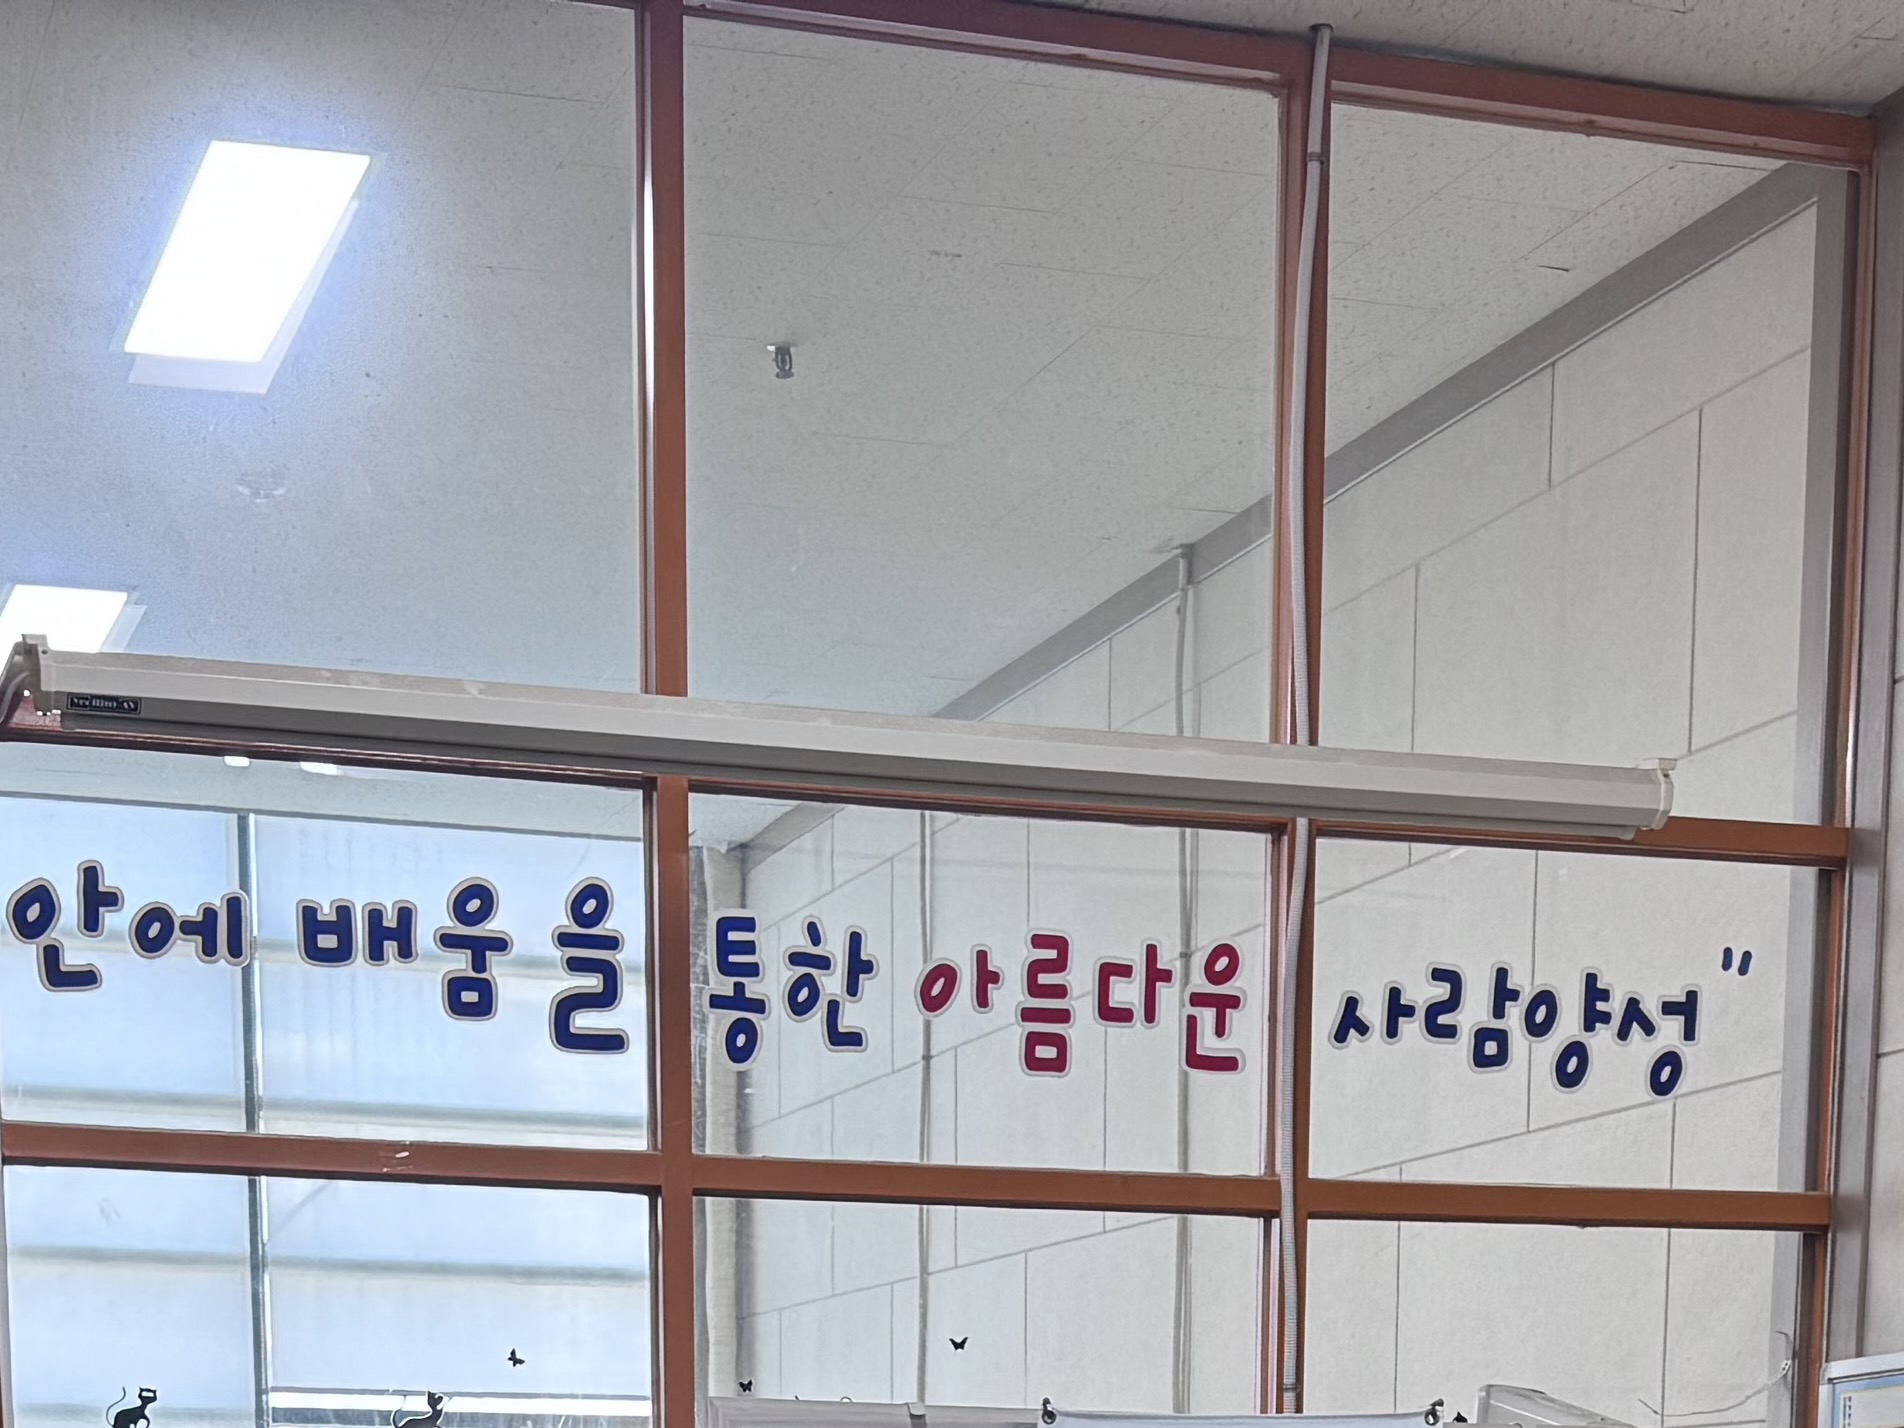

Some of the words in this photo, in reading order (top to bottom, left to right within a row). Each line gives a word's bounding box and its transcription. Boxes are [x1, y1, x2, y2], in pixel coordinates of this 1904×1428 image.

[7, 860, 250, 992] 안에
[706, 909, 876, 1068] 통한
[916, 930, 1245, 1078] 아름다운
